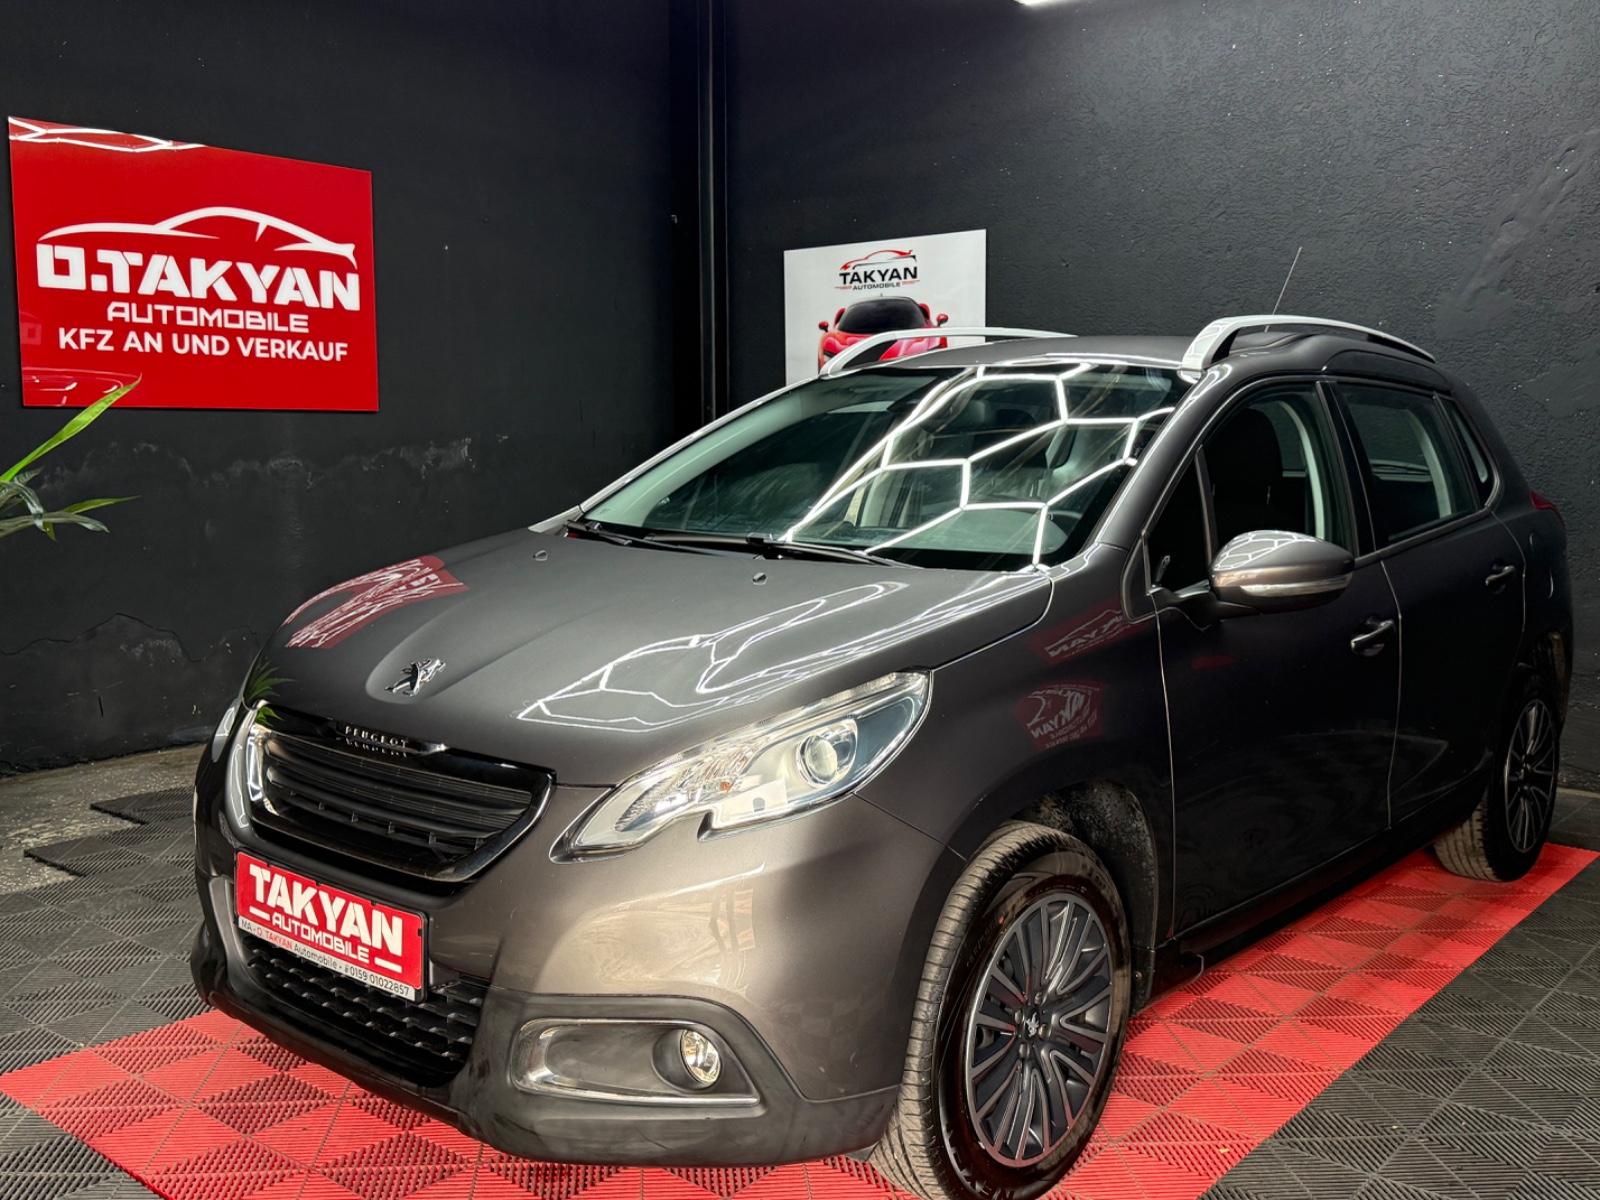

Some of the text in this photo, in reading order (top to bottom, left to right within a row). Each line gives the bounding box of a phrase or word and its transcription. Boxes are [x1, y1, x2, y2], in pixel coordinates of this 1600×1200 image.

[839, 267, 918, 285] TAKYAN
[852, 282, 901, 290] AUTOMOBILE
[107, 301, 309, 333] AUTOMOBILE
[58, 327, 348, 361] KFZ AN UND VERKAUF
[345, 725, 408, 748] PEUGEOT
[250, 863, 403, 957] TAKYAN
[272, 912, 369, 964] AUTOMOBILE
[265, 930, 293, 950] TAKYAN
[294, 944, 337, 970] Automobile
[369, 974, 410, 997] 01022857
